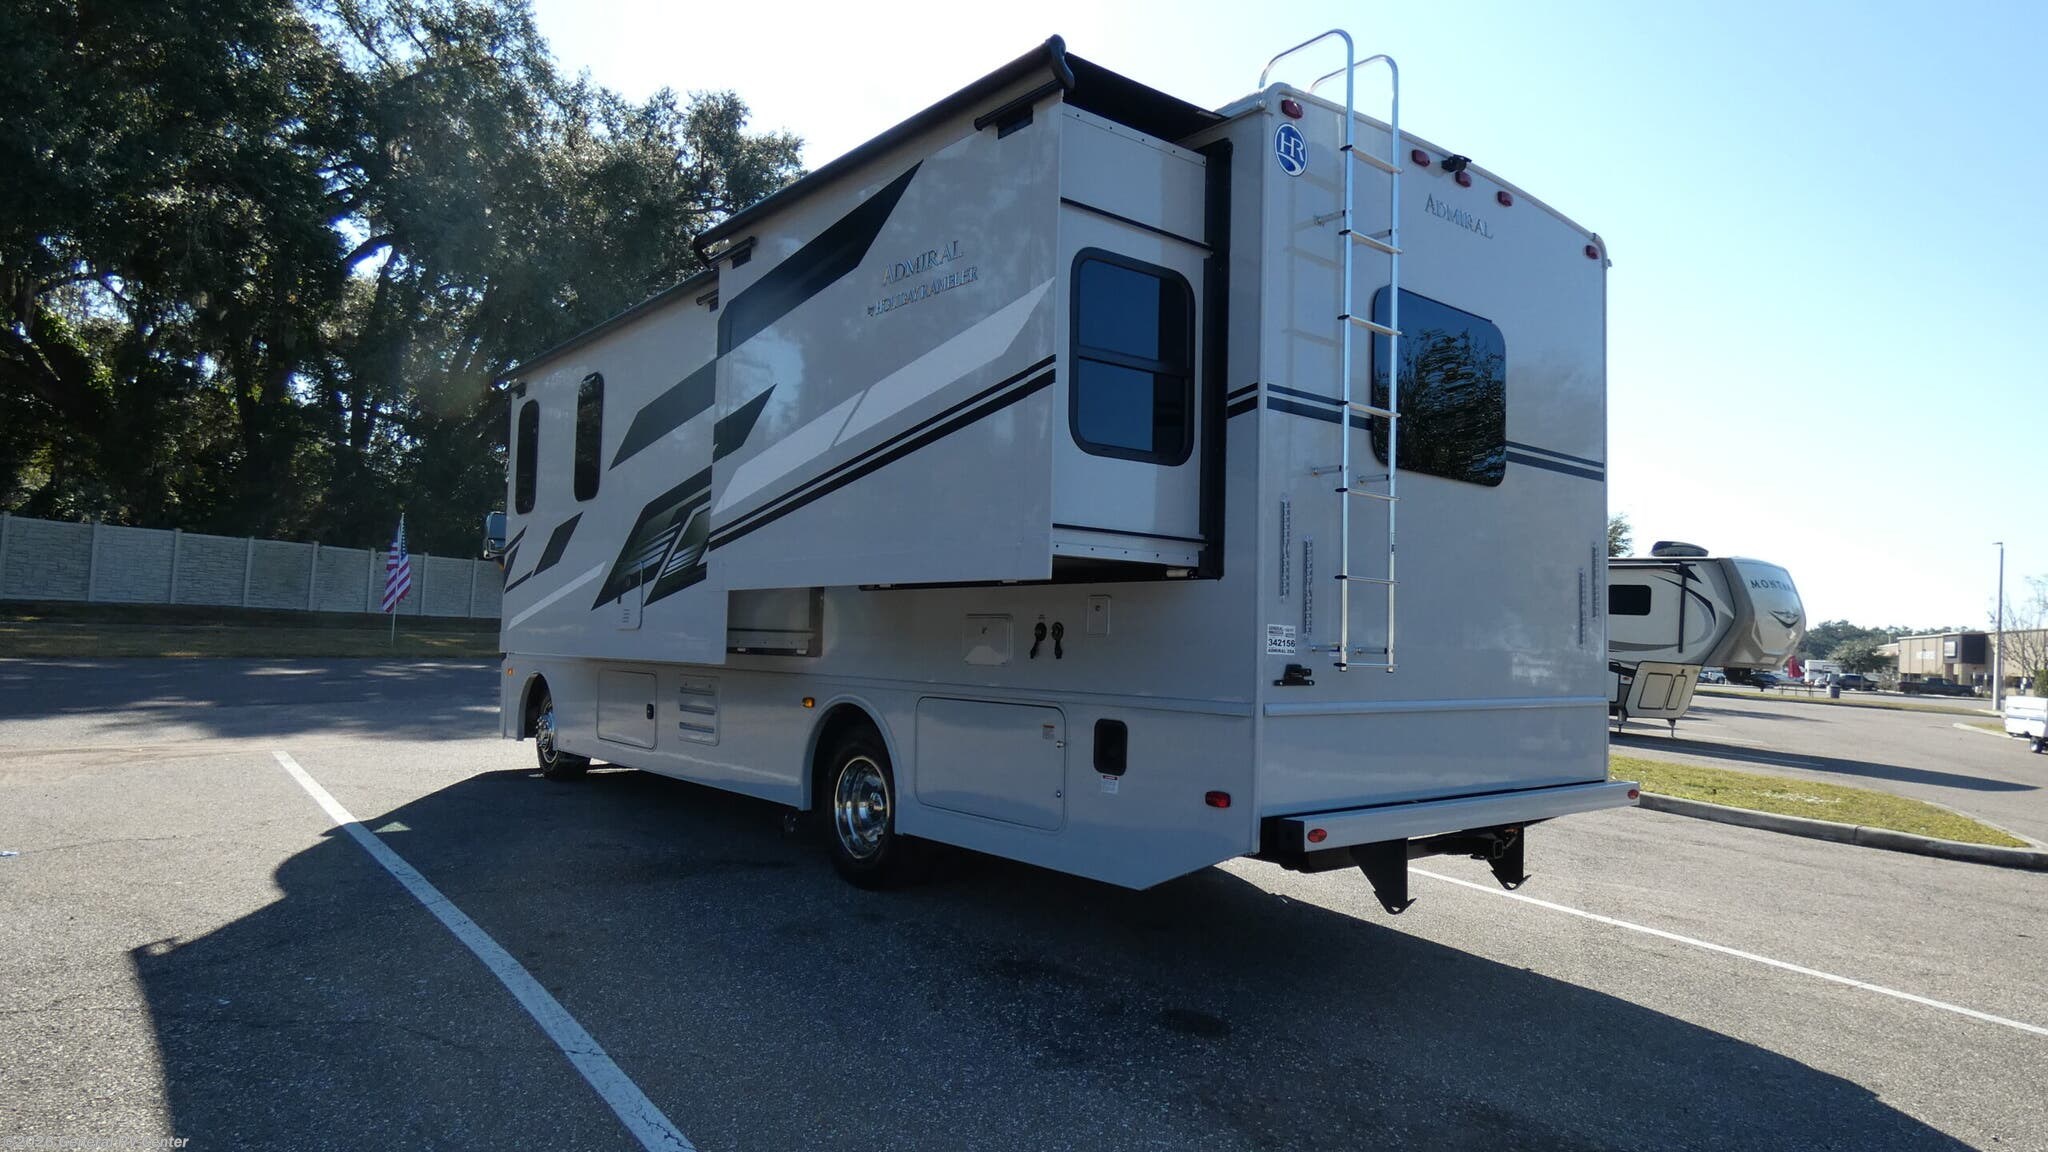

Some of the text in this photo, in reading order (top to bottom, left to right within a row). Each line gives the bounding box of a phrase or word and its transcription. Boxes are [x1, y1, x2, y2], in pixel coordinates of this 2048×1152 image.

[1280, 132, 1304, 162] HR
[1425, 193, 1494, 239] ADMIRAL
[883, 240, 964, 286] ADMIRAL
[1268, 638, 1296, 648] 342156
